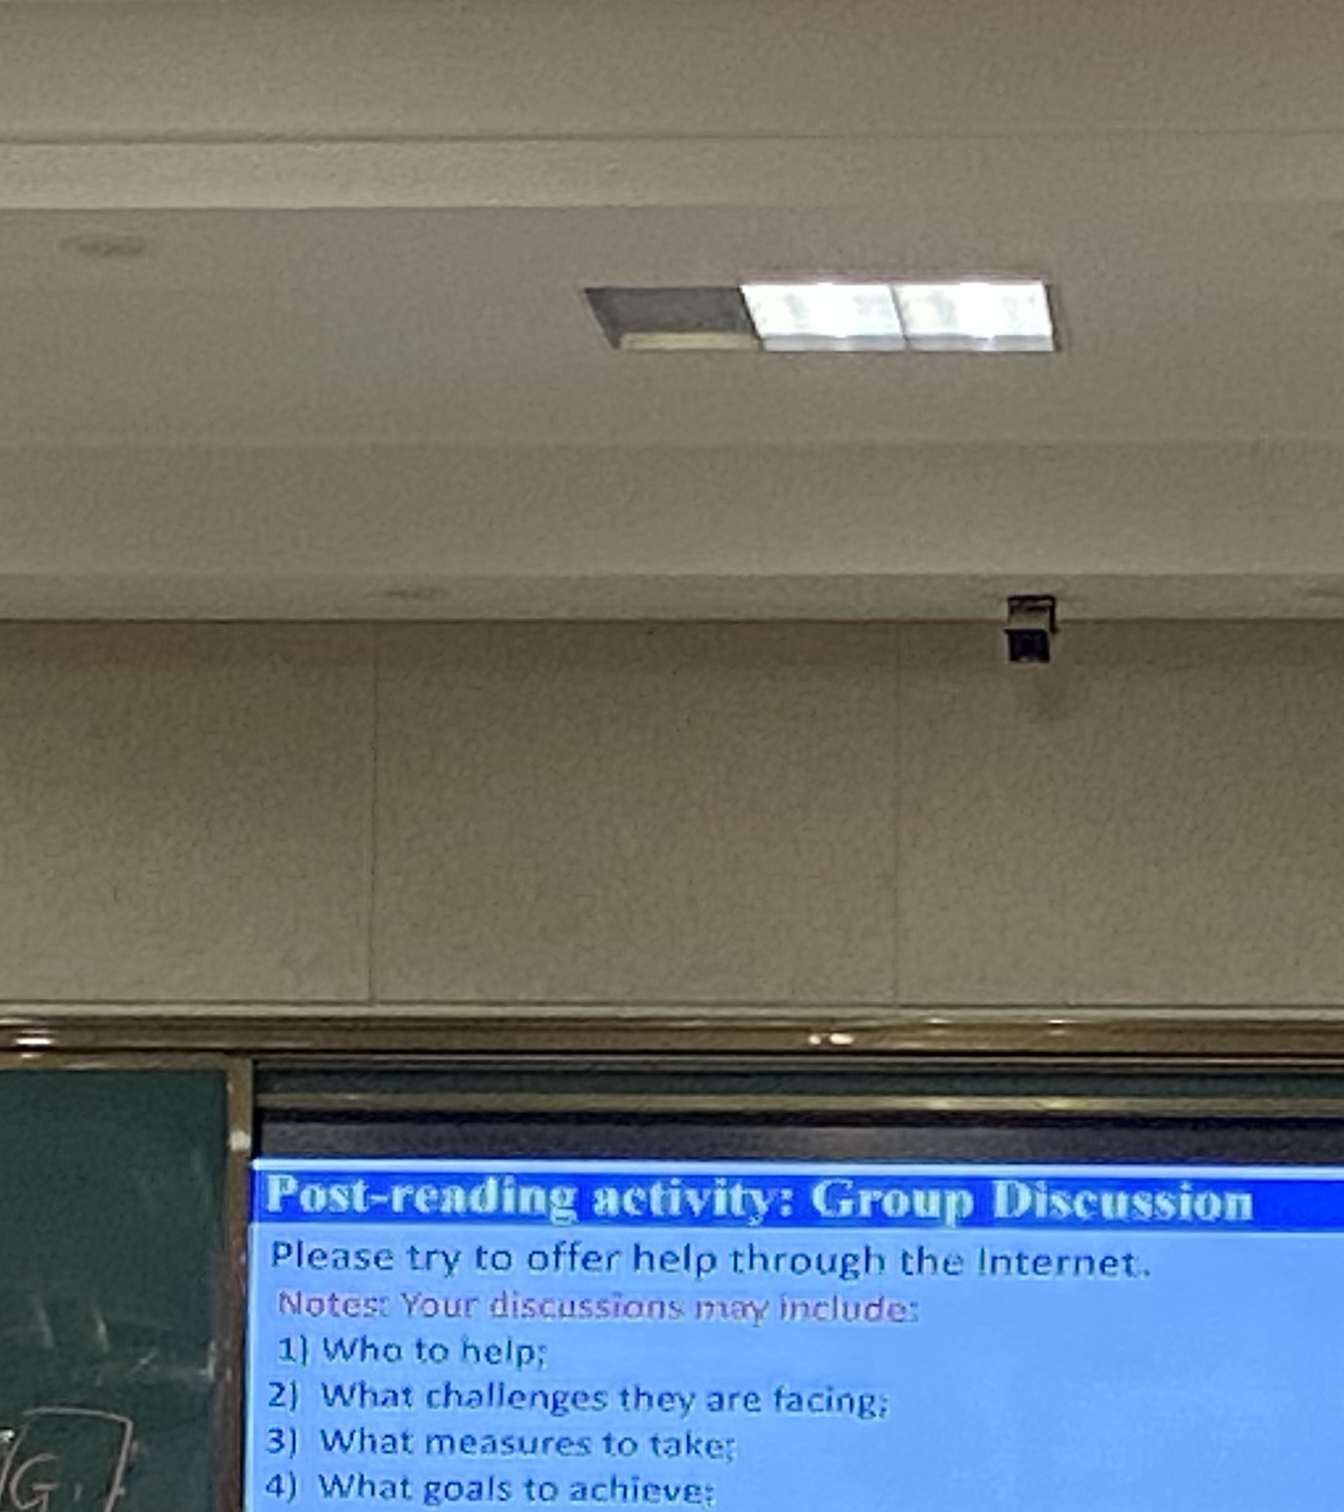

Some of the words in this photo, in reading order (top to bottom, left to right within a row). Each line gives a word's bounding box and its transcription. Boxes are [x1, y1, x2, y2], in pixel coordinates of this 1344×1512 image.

[266, 1172, 578, 1223] Post-reading
[593, 1175, 794, 1225] activity:
[812, 1178, 975, 1228] Group
[993, 1180, 1254, 1223] Discussion
[271, 1240, 395, 1272] Please
[407, 1246, 459, 1278] try
[476, 1246, 512, 1272] to
[527, 1240, 621, 1273] offer
[634, 1241, 718, 1279] help
[730, 1242, 886, 1281] through
[900, 1246, 964, 1278] the
[978, 1246, 1152, 1280] Internet.
[278, 1290, 391, 1318] Notes:
[402, 1292, 479, 1320] Your
[489, 1292, 683, 1322] discussions
[695, 1299, 768, 1328] may
[779, 1296, 920, 1325] include:
[277, 1336, 309, 1368] 1)
[322, 1336, 404, 1364] Who
[415, 1339, 450, 1365] to
[462, 1337, 548, 1370] help;
[267, 1379, 300, 1412] 2)
[321, 1381, 414, 1411] What
[425, 1384, 609, 1419] challenges
[619, 1386, 695, 1420] they
[707, 1390, 763, 1414] are
[774, 1385, 890, 1421] facing;
[265, 1426, 298, 1458] 3)
[320, 1427, 413, 1457] What
[425, 1432, 592, 1458] measures
[603, 1431, 639, 1458] to
[650, 1430, 738, 1464] take;
[264, 1472, 298, 1503] 4)
[317, 1473, 411, 1503] What
[422, 1475, 512, 1508] goals
[524, 1475, 558, 1504] to
[569, 1477, 716, 1510] achieve;
